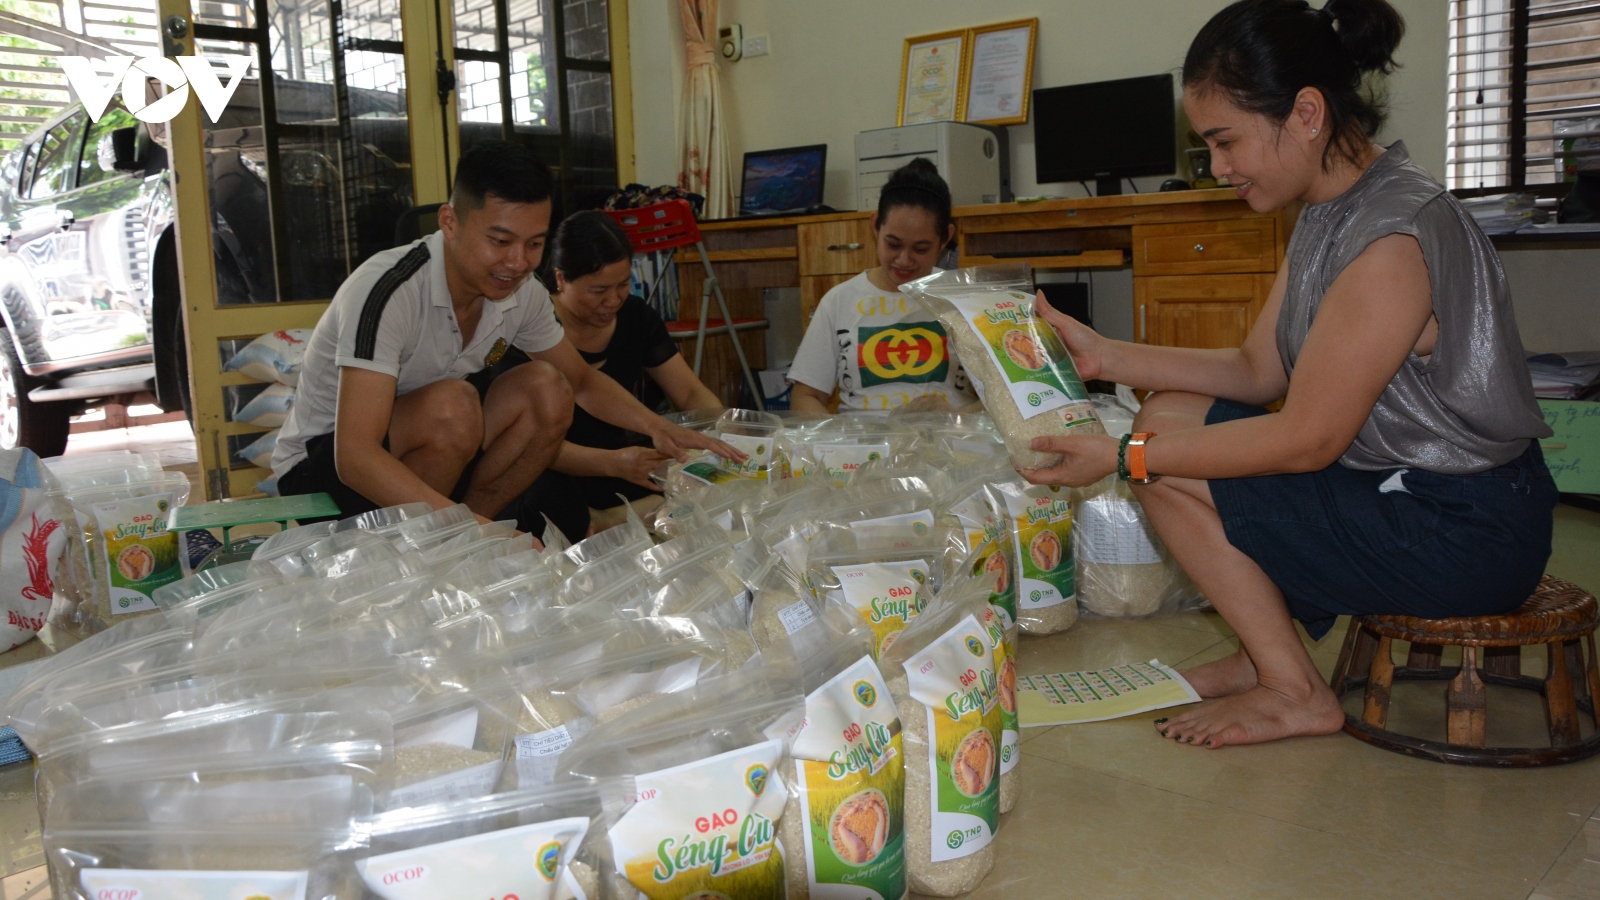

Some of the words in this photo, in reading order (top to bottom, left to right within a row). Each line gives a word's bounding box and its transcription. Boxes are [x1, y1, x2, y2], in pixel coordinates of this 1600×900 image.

[857, 296, 916, 316] GUC
[1040, 390, 1054, 398] TND
[945, 686, 986, 720] Séng
[827, 742, 875, 779] Séng
[694, 808, 738, 834] GẠO
[964, 825, 982, 838] TND
[653, 833, 732, 881] Séng
[738, 812, 774, 857] Cù
[382, 866, 425, 886] OCOP
[97, 888, 138, 900] OCOP
